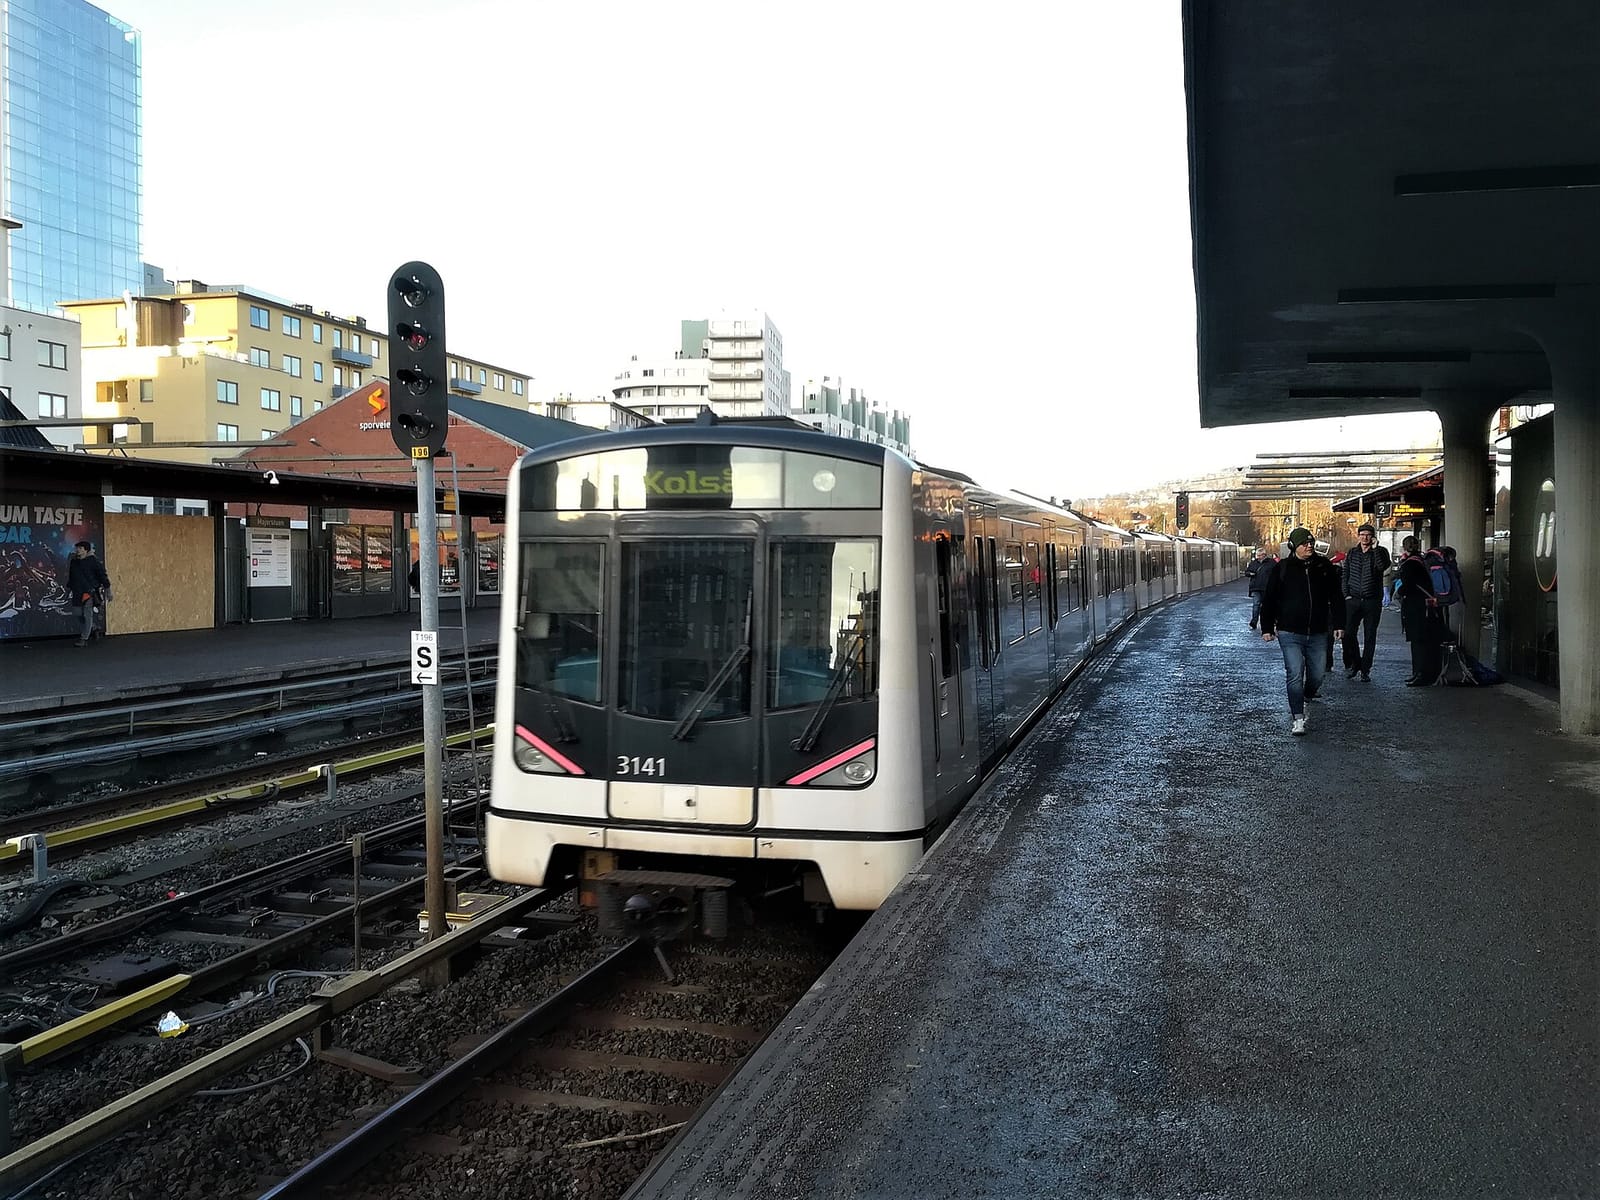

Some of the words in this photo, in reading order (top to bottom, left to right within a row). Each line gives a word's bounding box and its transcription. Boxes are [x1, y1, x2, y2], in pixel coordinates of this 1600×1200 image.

[413, 448, 428, 457] 196
[34, 506, 83, 525] TASTE
[1378, 505, 1385, 514] 2
[415, 634, 433, 642] T196
[416, 646, 432, 668] S
[616, 755, 666, 776] 3141
